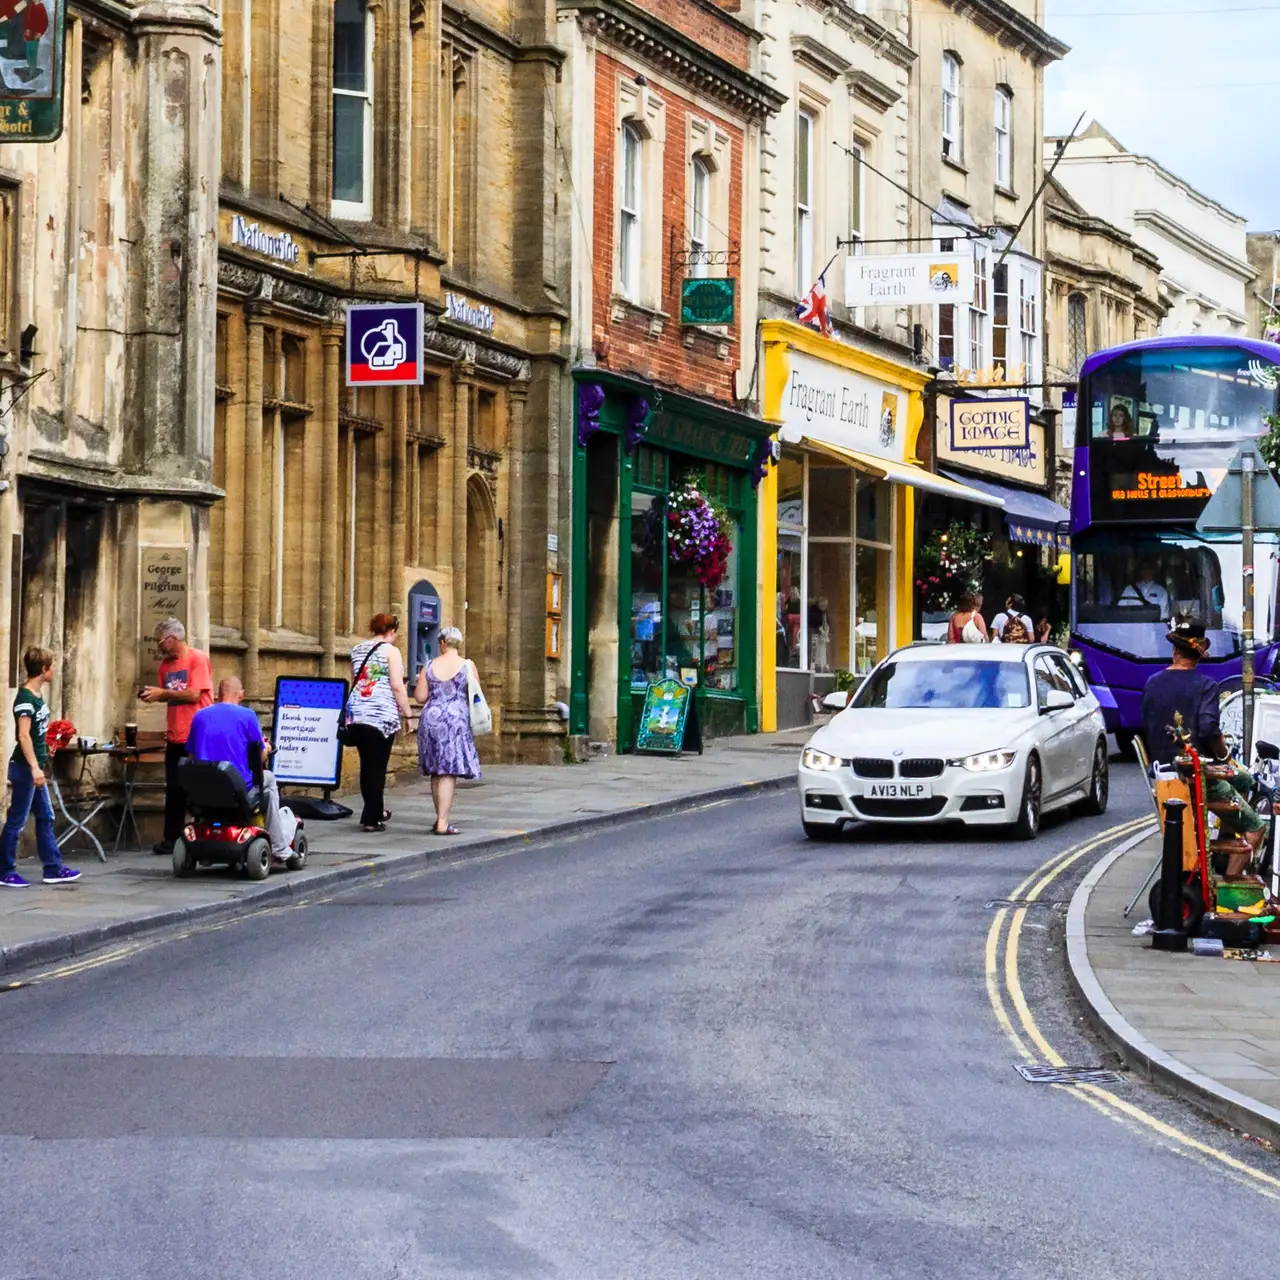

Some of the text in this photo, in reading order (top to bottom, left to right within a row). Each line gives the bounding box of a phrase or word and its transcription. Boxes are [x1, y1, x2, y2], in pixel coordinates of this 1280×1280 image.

[18, 101, 28, 116] &
[0, 119, 32, 135] Hotel
[232, 215, 299, 263] Nationwide
[861, 264, 915, 282] Fragrant
[870, 282, 906, 296] Earth
[445, 291, 495, 332] Nationwide
[790, 370, 869, 428] Fragrant Earth
[1137, 472, 1182, 489] Street
[147, 564, 181, 575] George
[144, 582, 185, 592] Pilgrims
[871, 784, 924, 797] AV13 NLP
